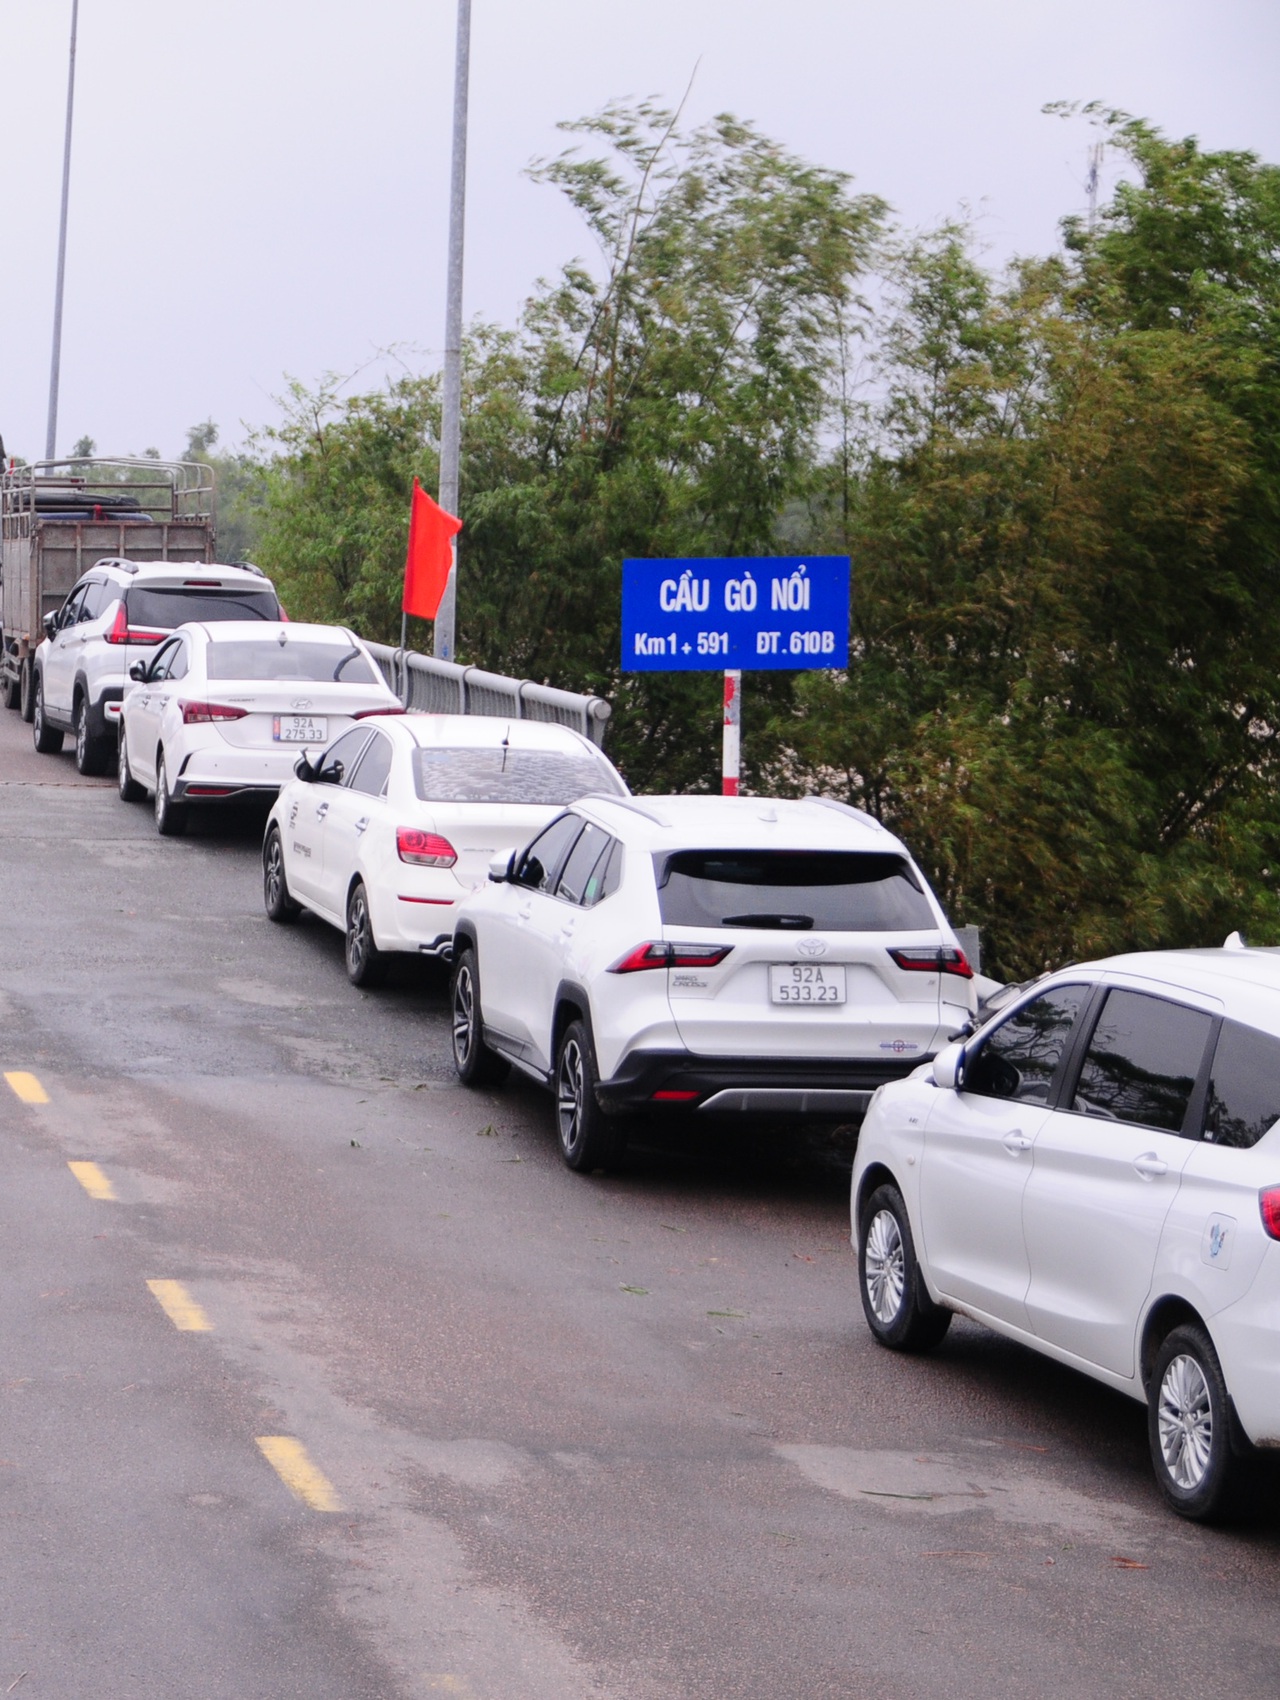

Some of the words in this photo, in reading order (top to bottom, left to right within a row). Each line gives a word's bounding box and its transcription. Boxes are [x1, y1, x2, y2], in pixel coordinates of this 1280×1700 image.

[659, 569, 710, 612] CẦU
[724, 571, 758, 612] GÒ
[771, 564, 811, 611] NỔI
[293, 717, 314, 728] 92A
[285, 728, 323, 740] 275.33
[792, 967, 824, 983] 92A
[780, 985, 838, 1001] 533.23
